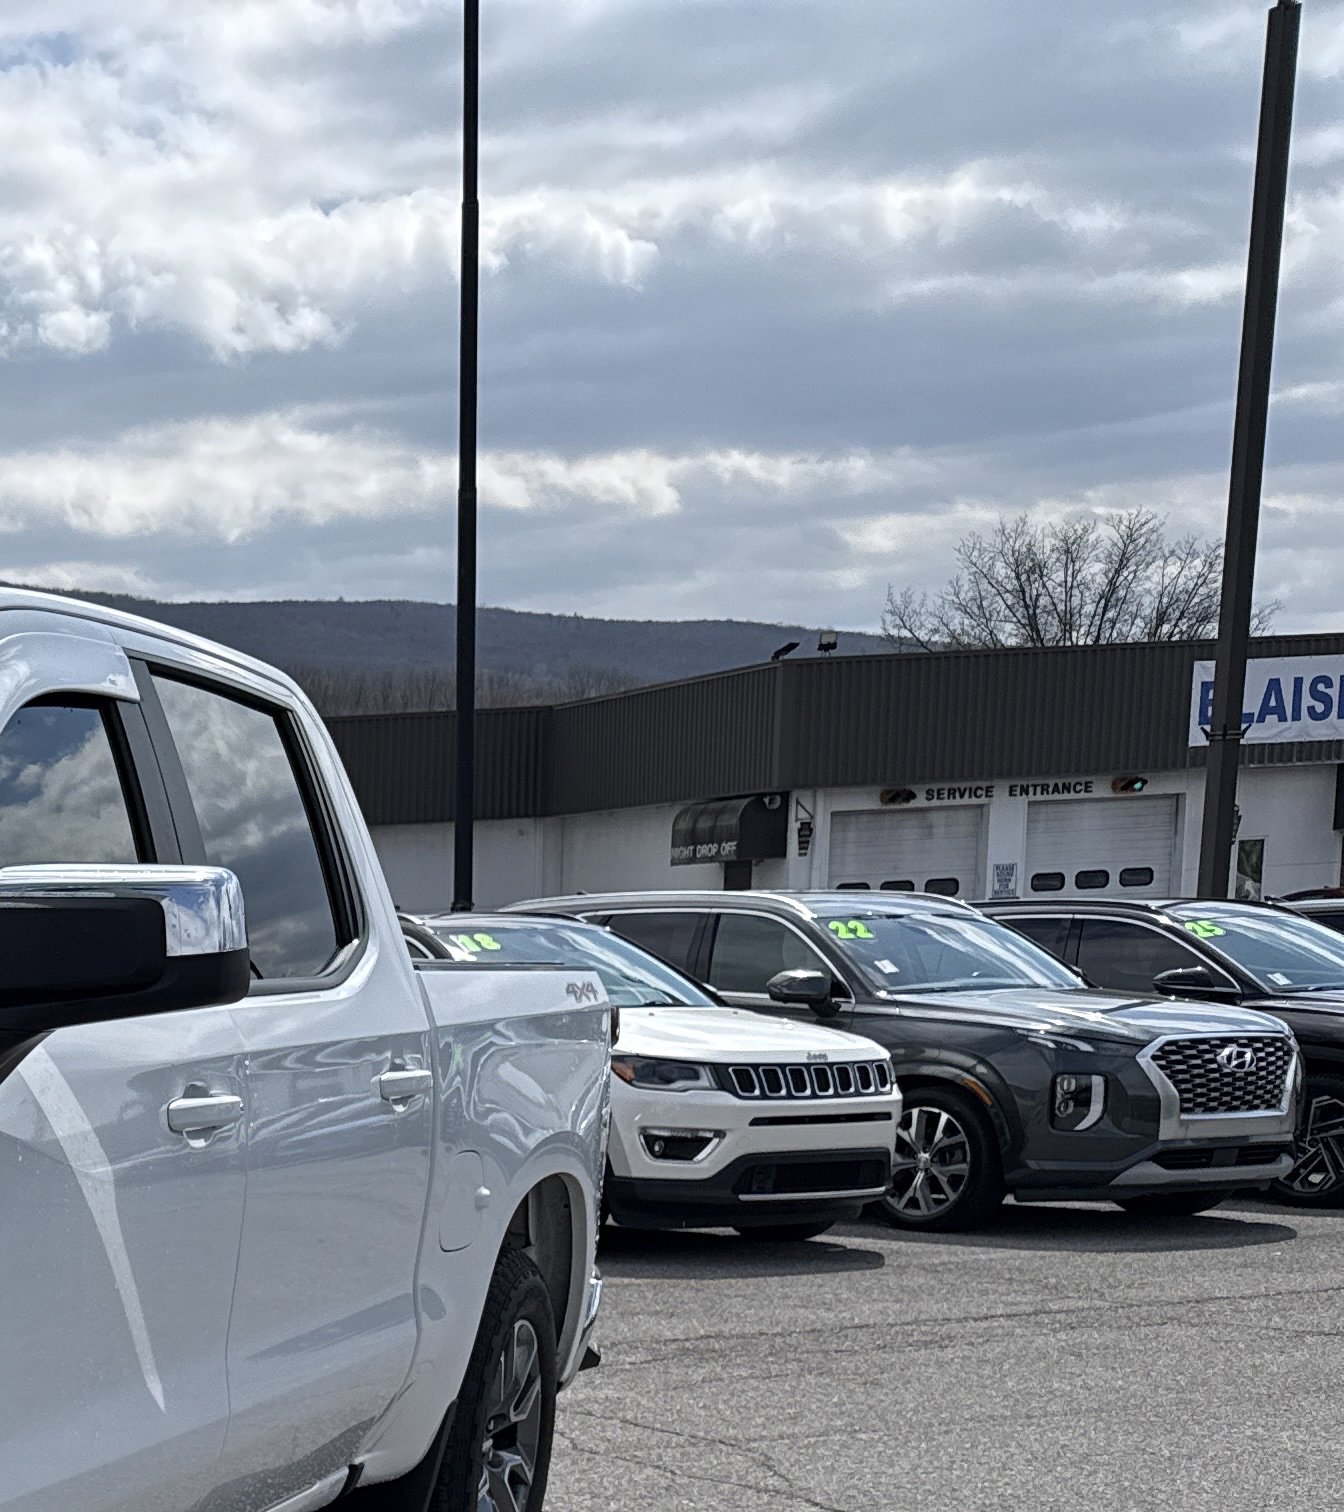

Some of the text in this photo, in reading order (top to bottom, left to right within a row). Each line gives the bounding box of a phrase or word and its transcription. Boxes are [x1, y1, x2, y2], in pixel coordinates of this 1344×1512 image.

[925, 780, 1094, 801] SERVICE ENTRANCE
[696, 843, 718, 858] DROP
[720, 841, 738, 856] OFF
[828, 920, 874, 939] 22
[1184, 920, 1226, 938] 25
[456, 933, 501, 952] 18
